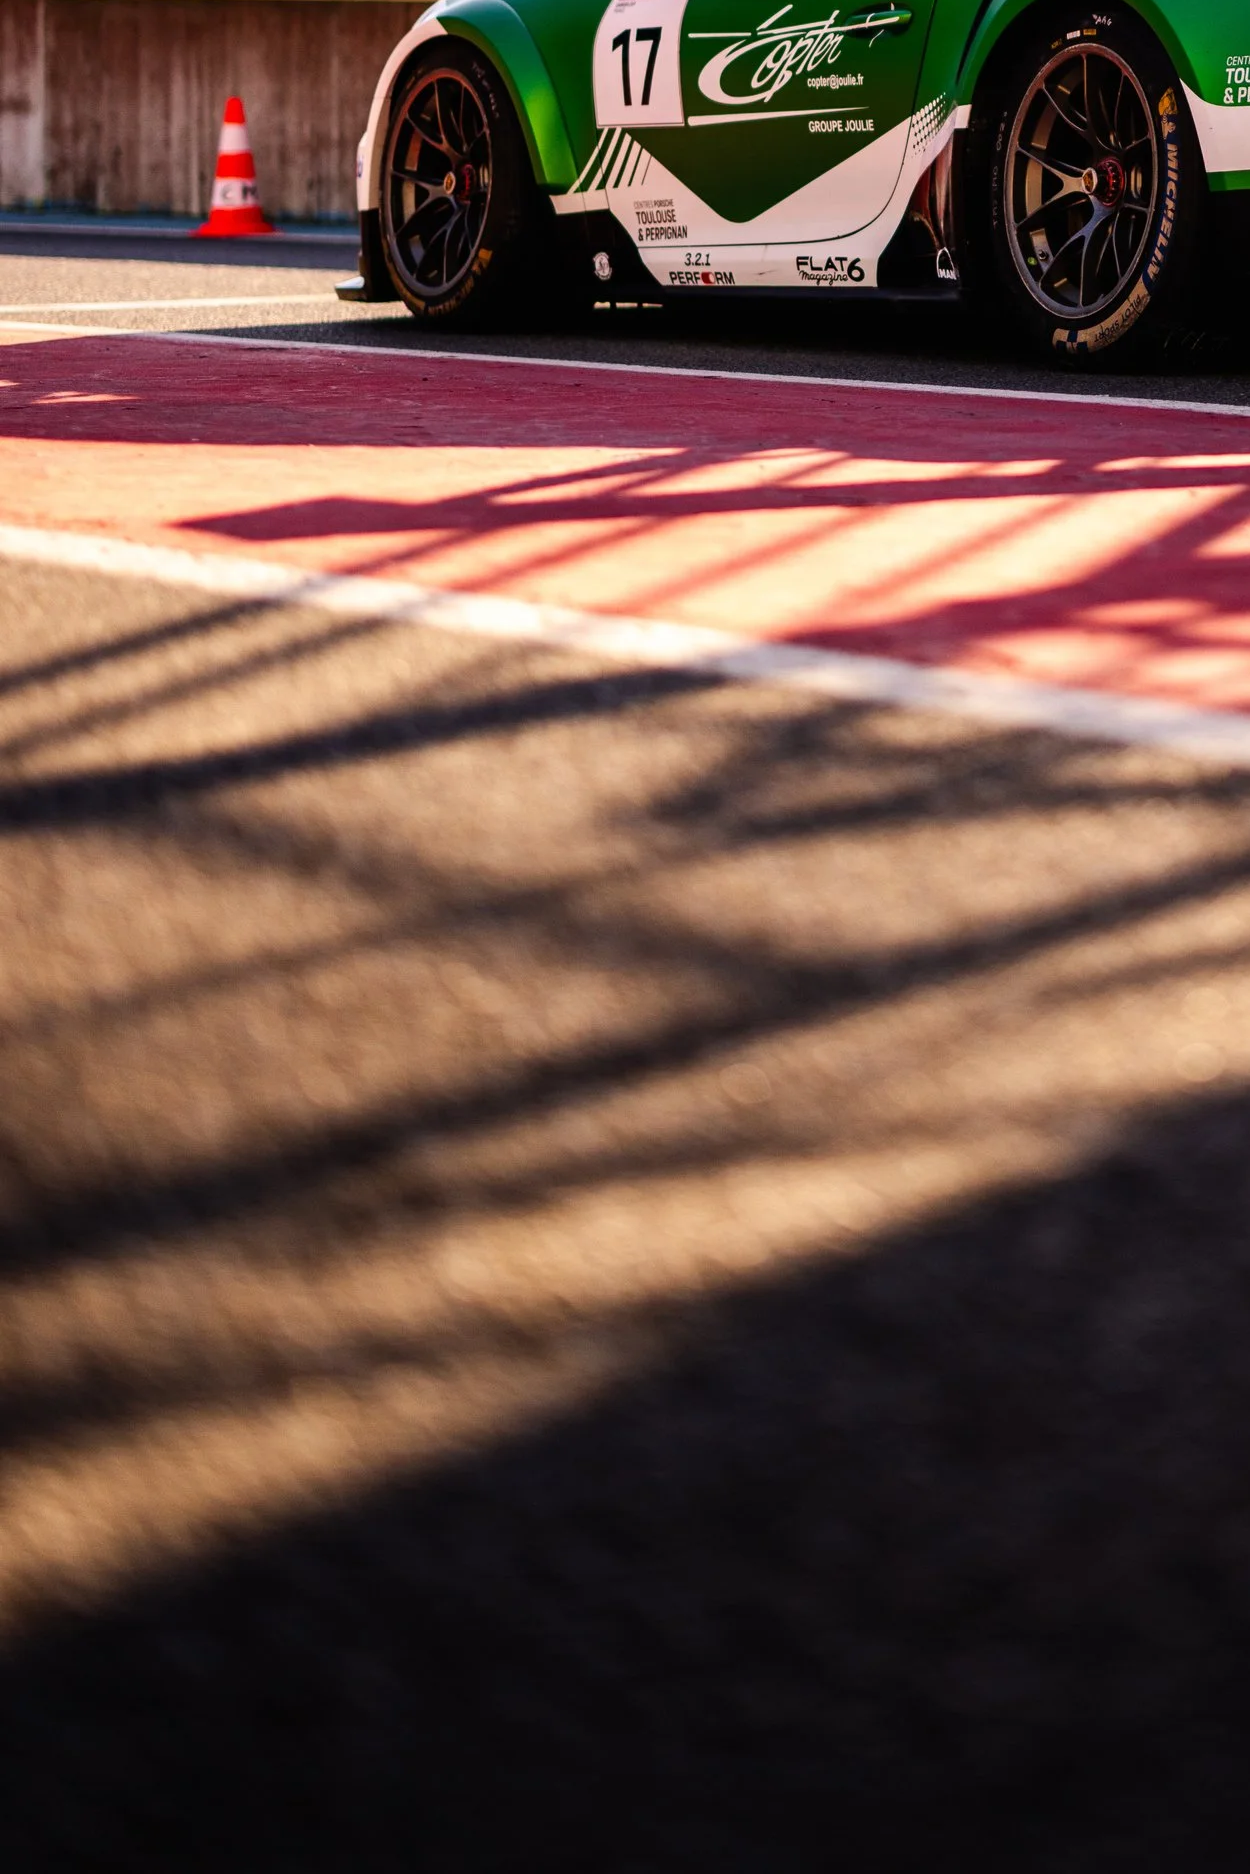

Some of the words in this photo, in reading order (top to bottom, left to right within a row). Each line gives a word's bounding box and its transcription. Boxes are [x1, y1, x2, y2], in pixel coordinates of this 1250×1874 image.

[698, 10, 846, 105] Copter
[611, 26, 663, 107] 17
[807, 73, 864, 89] copter@joulie.fr
[1223, 87, 1234, 104] &
[808, 120, 843, 133] GROUPE
[845, 119, 875, 132] JOULIE
[636, 209, 677, 225] TOULOUSE
[638, 228, 644, 242] &
[645, 225, 688, 241] PERPIGNAN
[684, 253, 711, 267] 3.2.1
[796, 256, 848, 272] FLAT
[847, 257, 866, 282] 6
[798, 270, 848, 286] magazine
